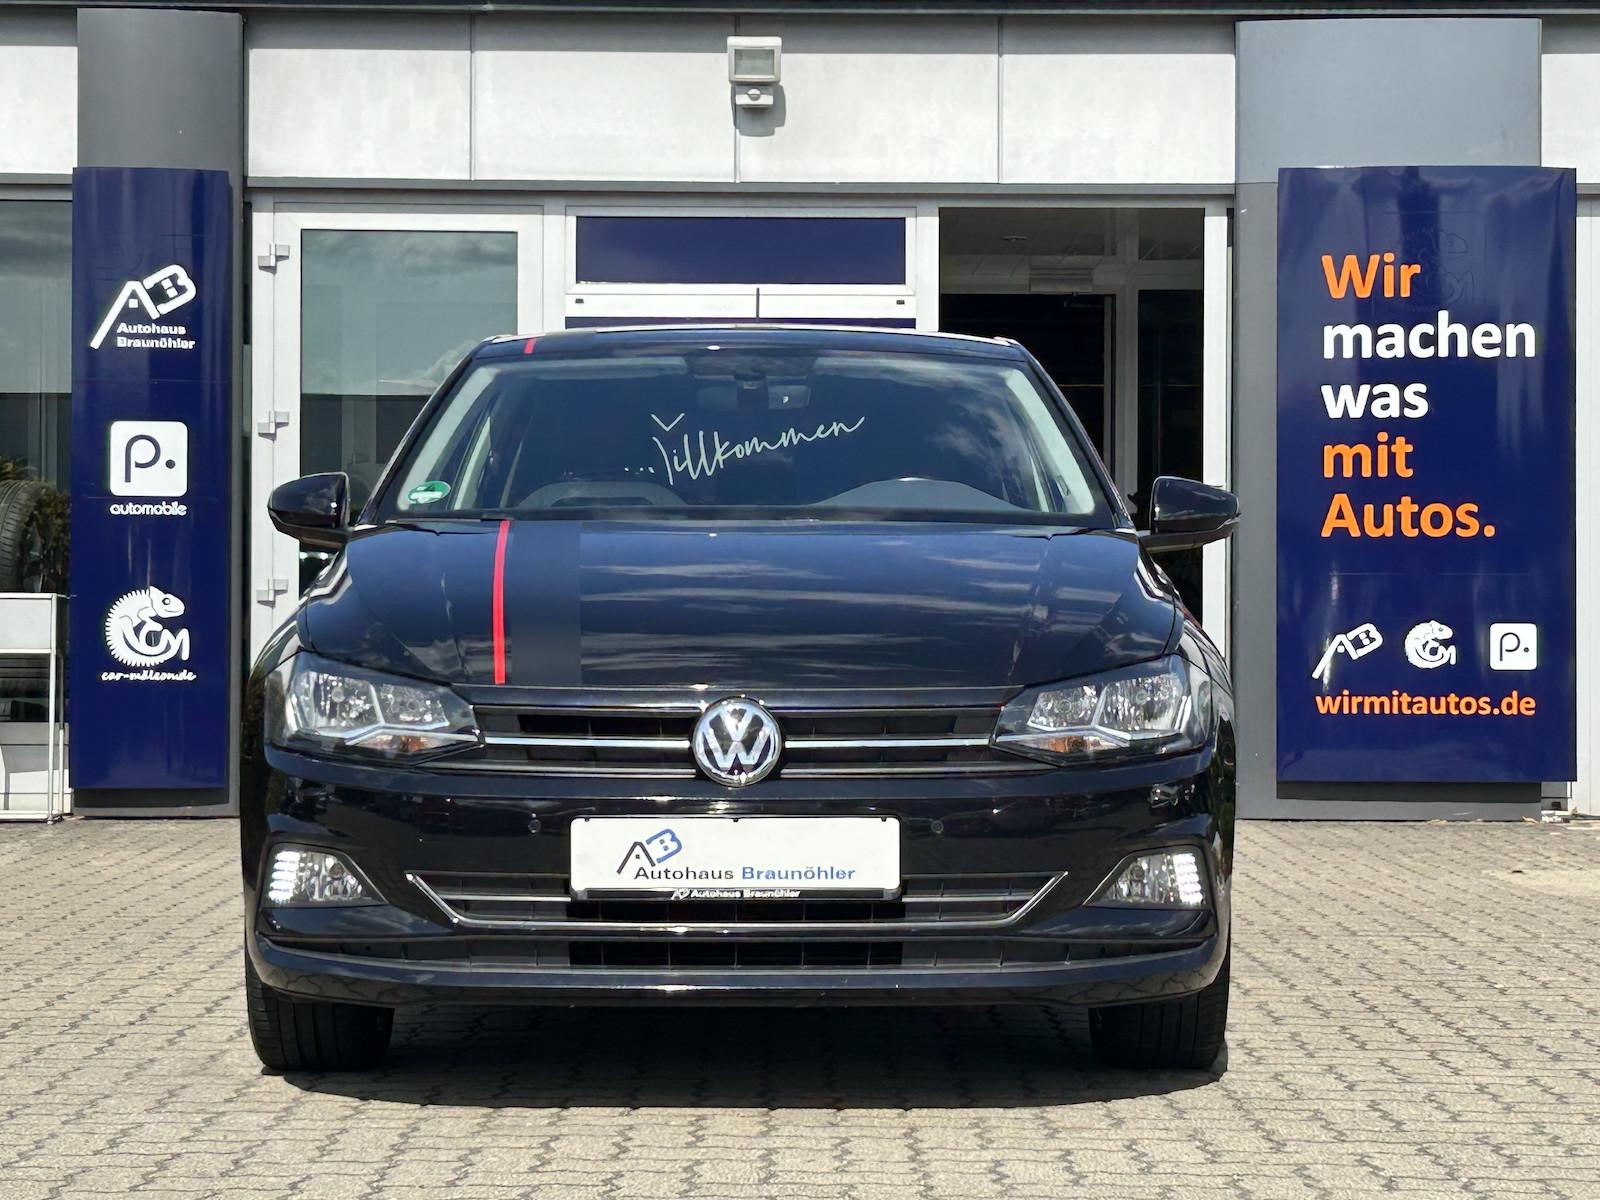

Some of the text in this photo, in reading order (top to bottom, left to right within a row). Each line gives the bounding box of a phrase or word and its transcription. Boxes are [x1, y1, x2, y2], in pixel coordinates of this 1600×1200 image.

[1321, 252, 1421, 298] Wir
[116, 322, 186, 335] Autohaus
[1323, 310, 1536, 359] machen
[116, 337, 196, 349] Braunöhler
[1320, 383, 1429, 419] was
[1323, 431, 1414, 478] mit
[109, 502, 187, 516] automobile
[1320, 493, 1496, 538] Autos.
[1315, 690, 1537, 716] wirmitautos.de
[633, 866, 855, 880] Autohaus Braunöhler
[691, 889, 741, 898] Autohaus
